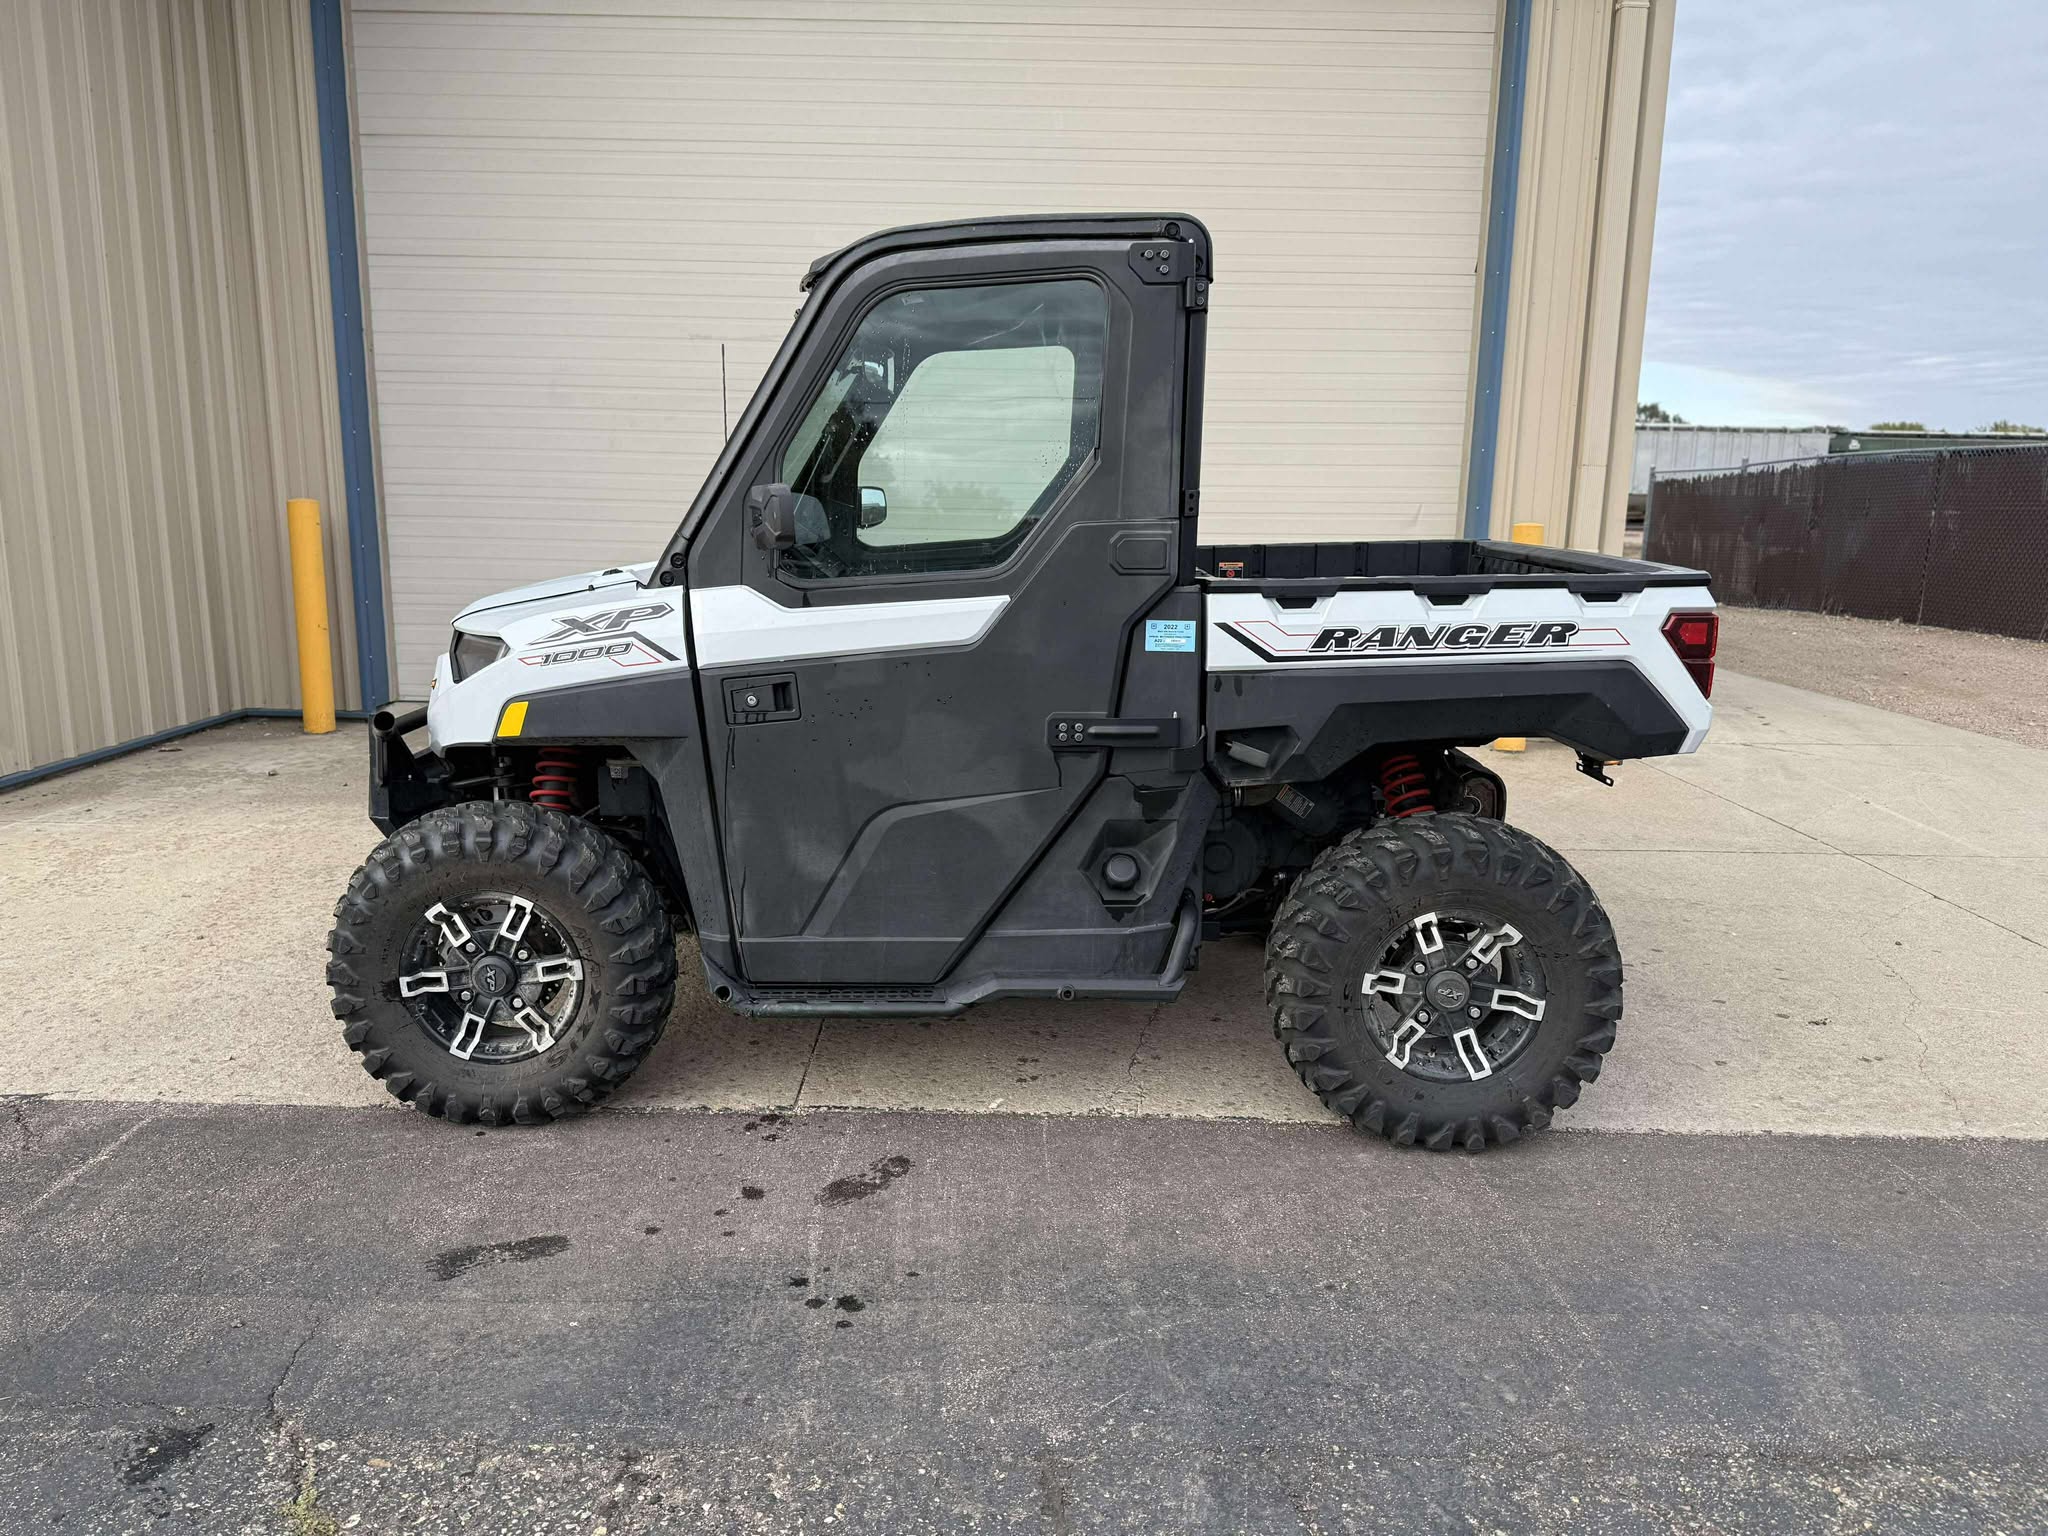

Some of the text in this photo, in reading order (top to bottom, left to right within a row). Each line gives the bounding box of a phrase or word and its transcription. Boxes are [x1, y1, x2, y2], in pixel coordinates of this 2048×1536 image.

[528, 602, 675, 645] XP
[1308, 620, 1580, 653] RANGER
[540, 641, 633, 666] 1000
[486, 966, 496, 991] XP
[1437, 987, 1464, 1001] XP
